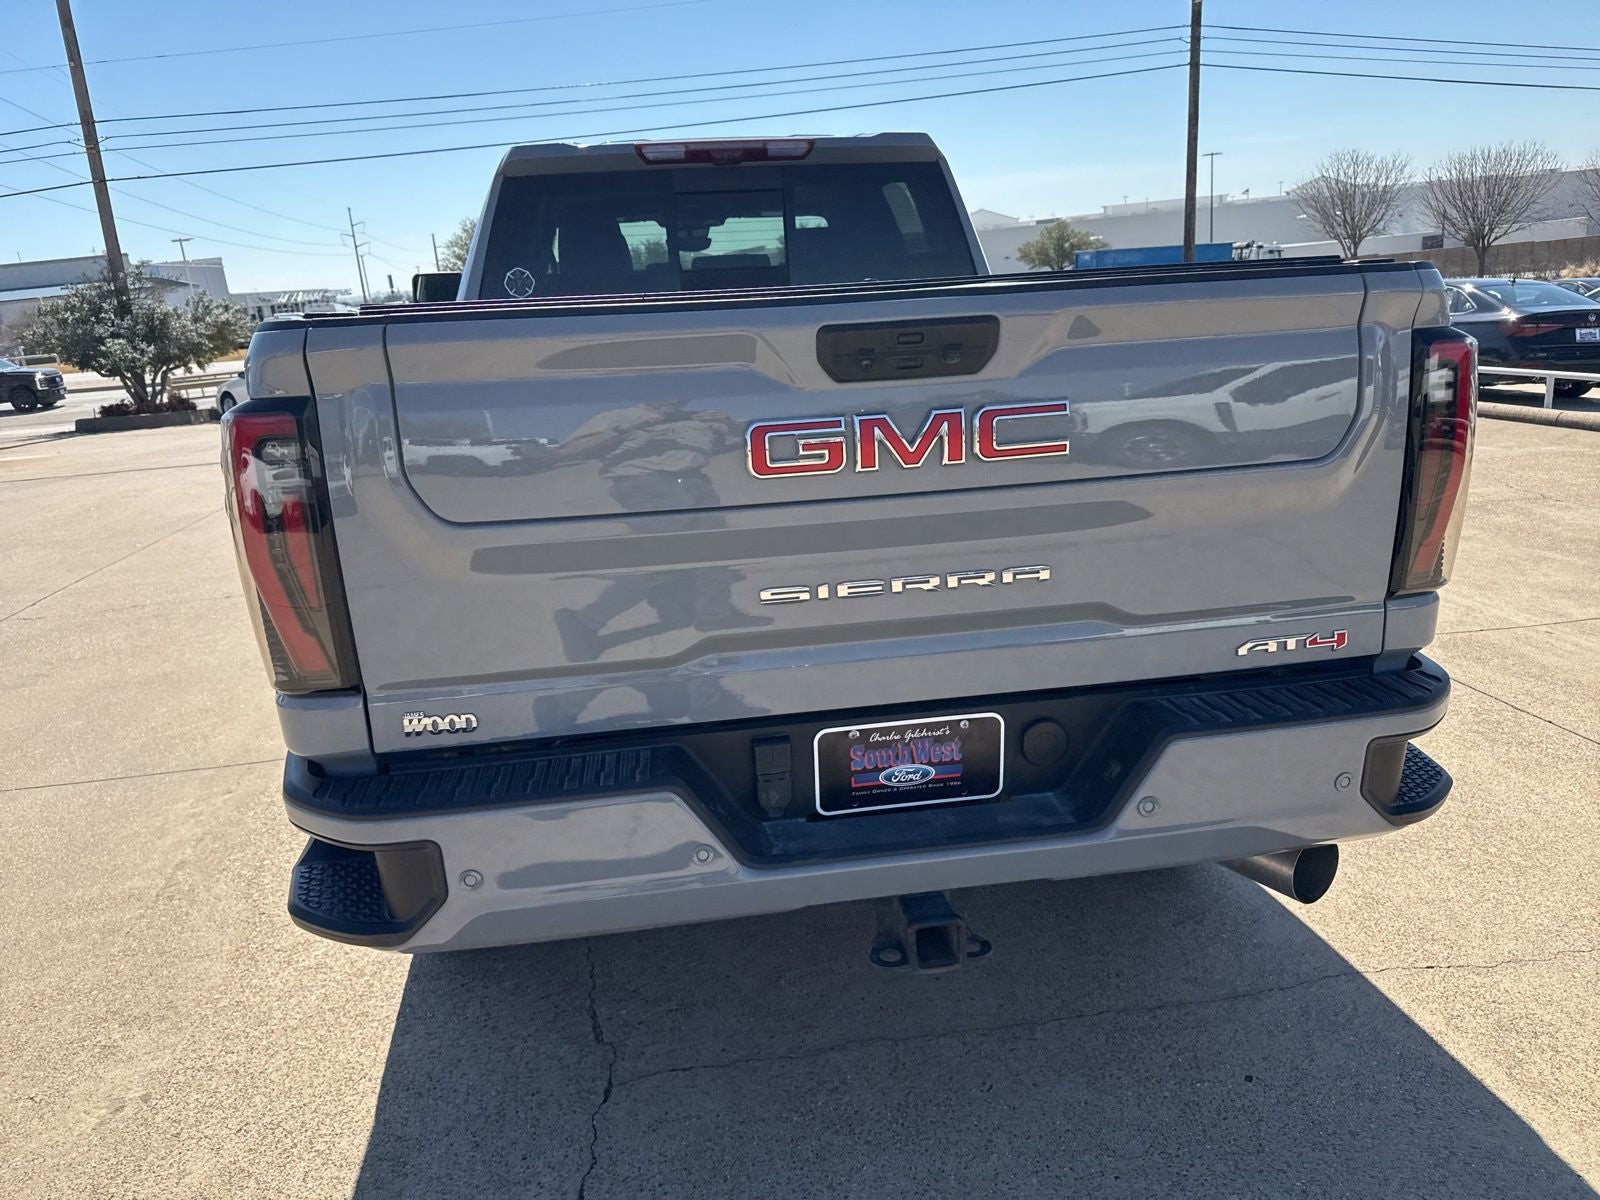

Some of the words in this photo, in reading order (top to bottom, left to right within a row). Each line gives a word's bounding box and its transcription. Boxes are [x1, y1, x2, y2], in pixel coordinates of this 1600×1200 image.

[745, 400, 1070, 478] GMC
[759, 565, 1051, 605] SIERRA
[1237, 629, 1348, 656] AT4
[403, 714, 478, 734] WOOD
[869, 731, 901, 742] Charlie
[904, 725, 951, 743] Gilchrist's
[891, 768, 923, 783] Ford
